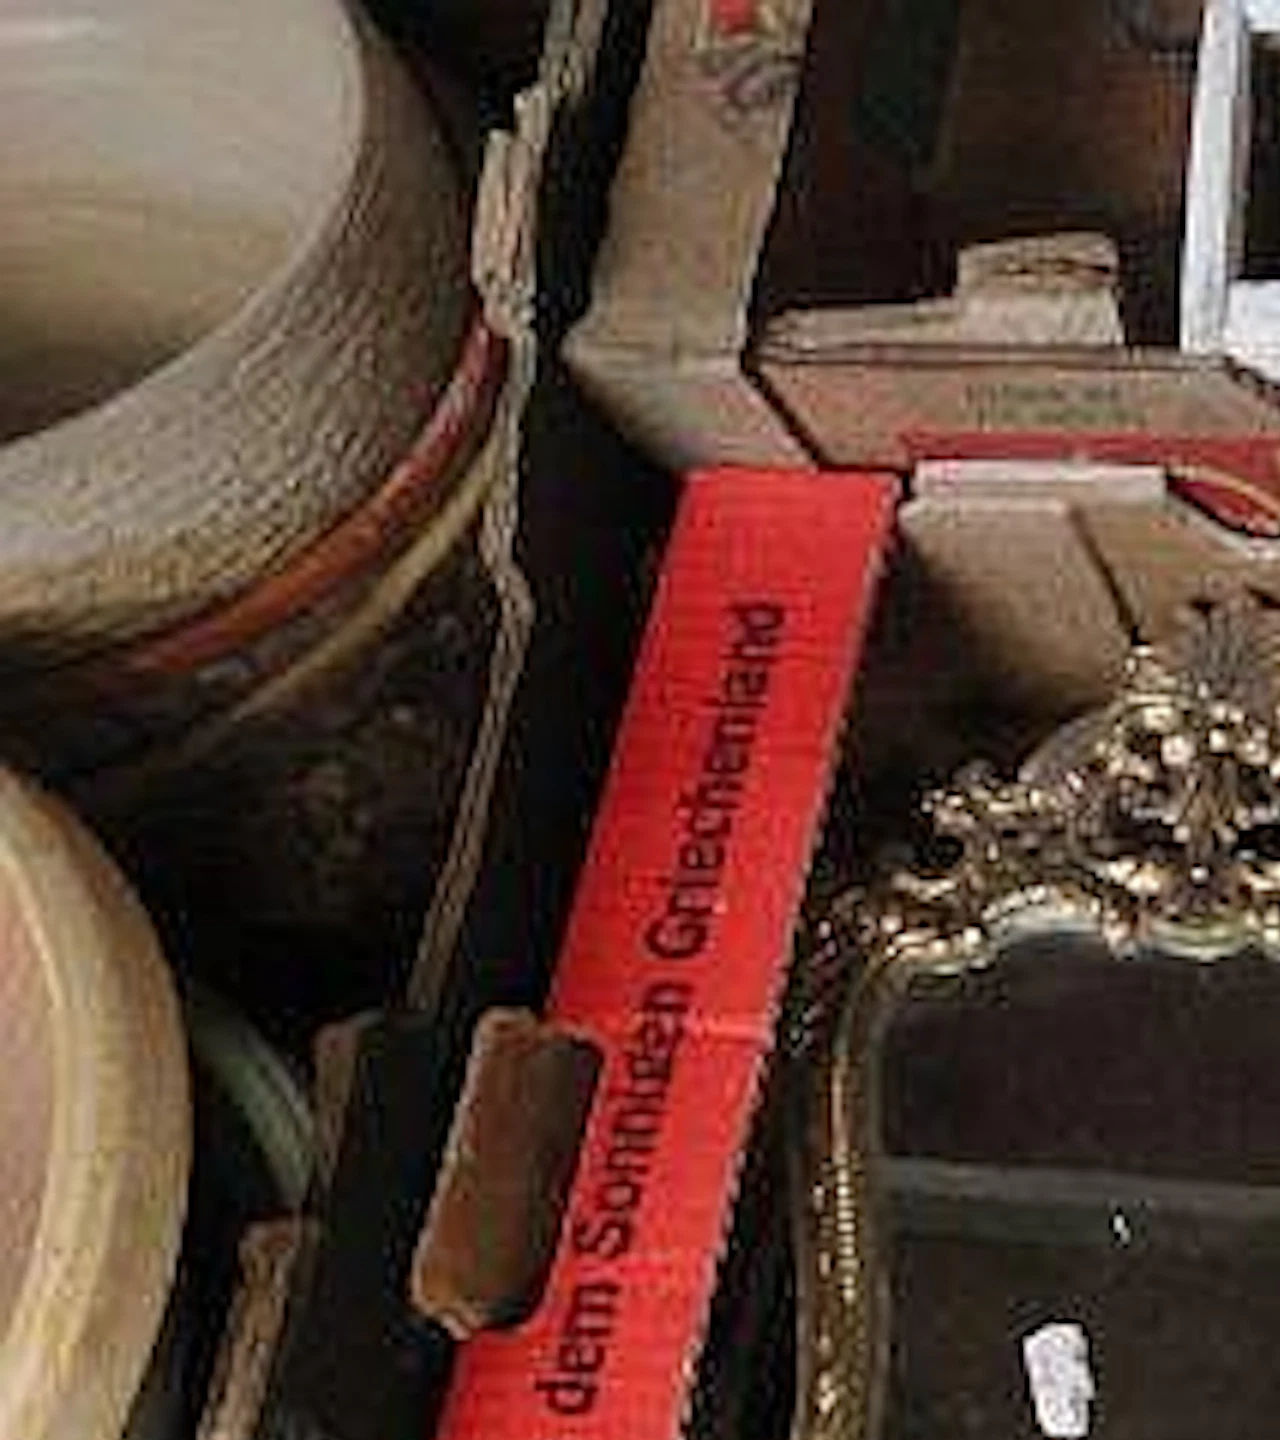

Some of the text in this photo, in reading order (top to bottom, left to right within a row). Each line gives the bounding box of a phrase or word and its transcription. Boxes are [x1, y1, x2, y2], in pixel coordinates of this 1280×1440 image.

[643, 601, 787, 961] Griechenland
[572, 979, 695, 1260] Sonnigen
[535, 1279, 622, 1418] dem
